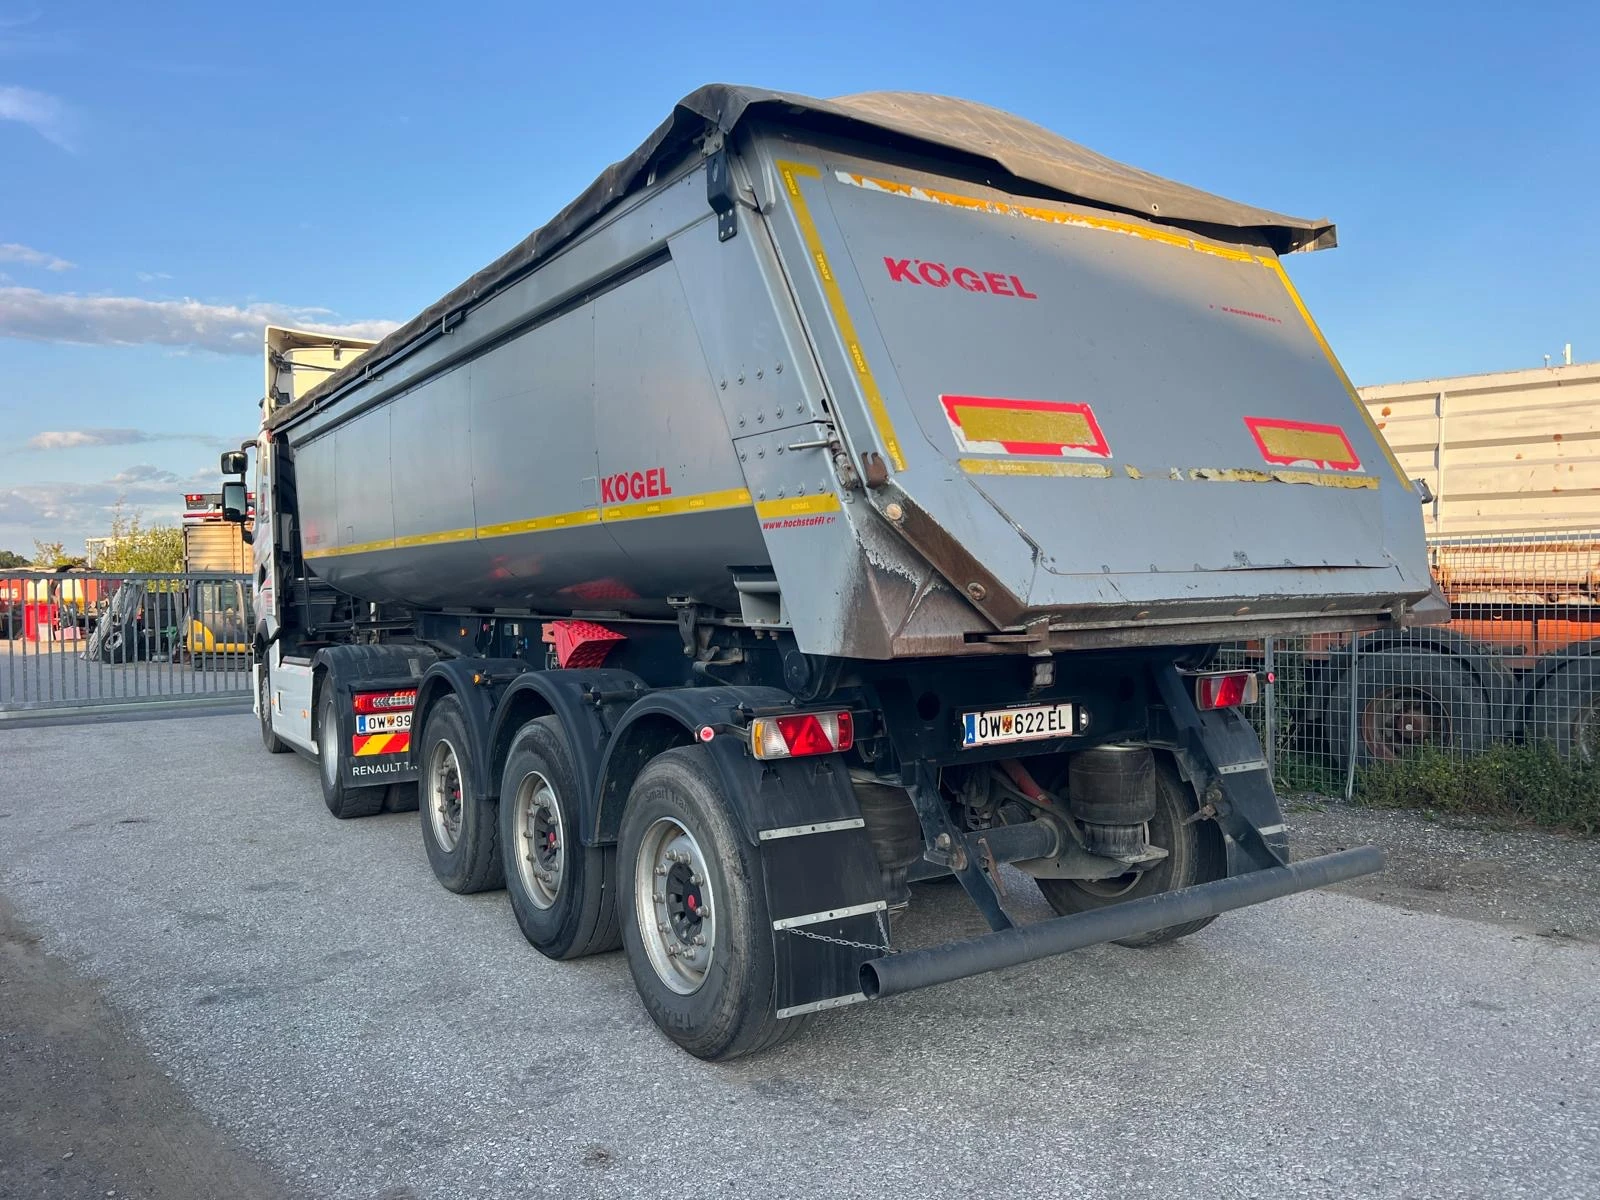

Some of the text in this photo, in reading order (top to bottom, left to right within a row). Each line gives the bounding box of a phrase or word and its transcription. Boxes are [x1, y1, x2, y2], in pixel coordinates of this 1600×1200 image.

[368, 716, 386, 730] OW
[978, 709, 1066, 739] OW 622 EL
[352, 762, 402, 776] RENAULT
